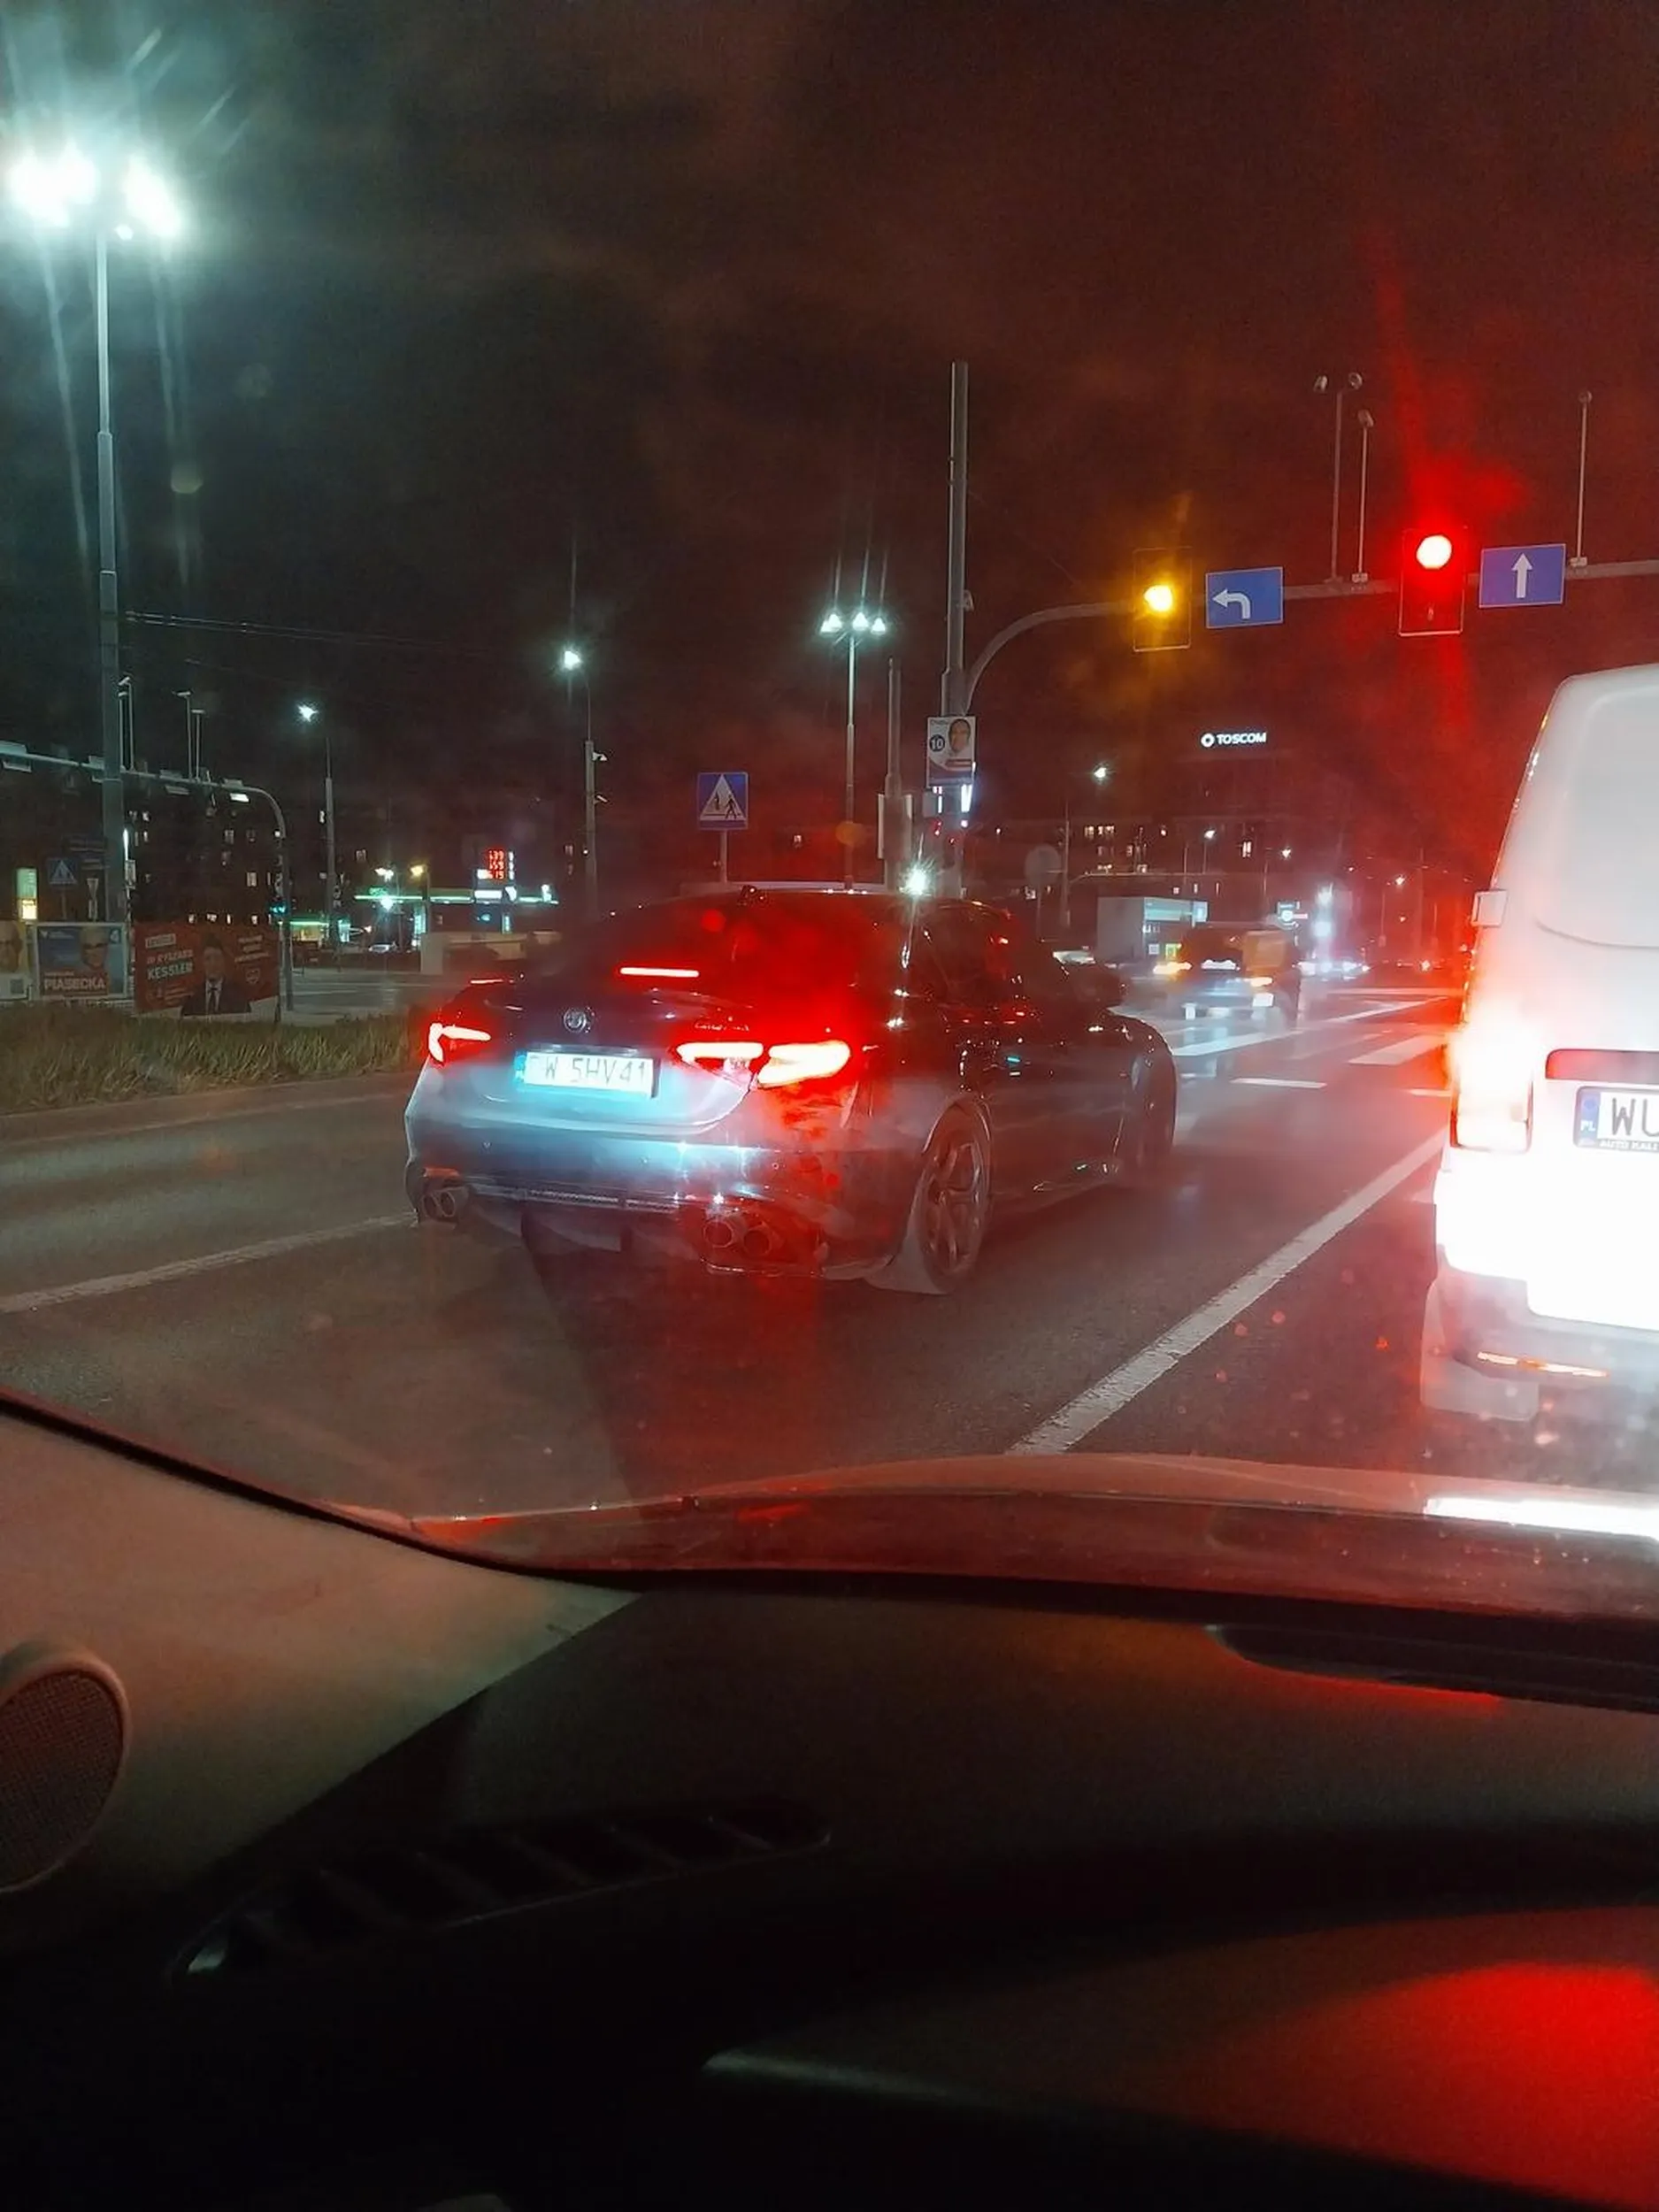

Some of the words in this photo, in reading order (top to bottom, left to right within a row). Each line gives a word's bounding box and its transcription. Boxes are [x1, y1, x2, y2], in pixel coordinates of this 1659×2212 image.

[931, 738, 944, 750] 10
[1217, 732, 1266, 745] TOSCOM
[147, 962, 194, 980] KESSLER
[44, 977, 106, 990] PIASECKA
[545, 1056, 559, 1080] W
[1580, 1119, 1596, 1132] PL
